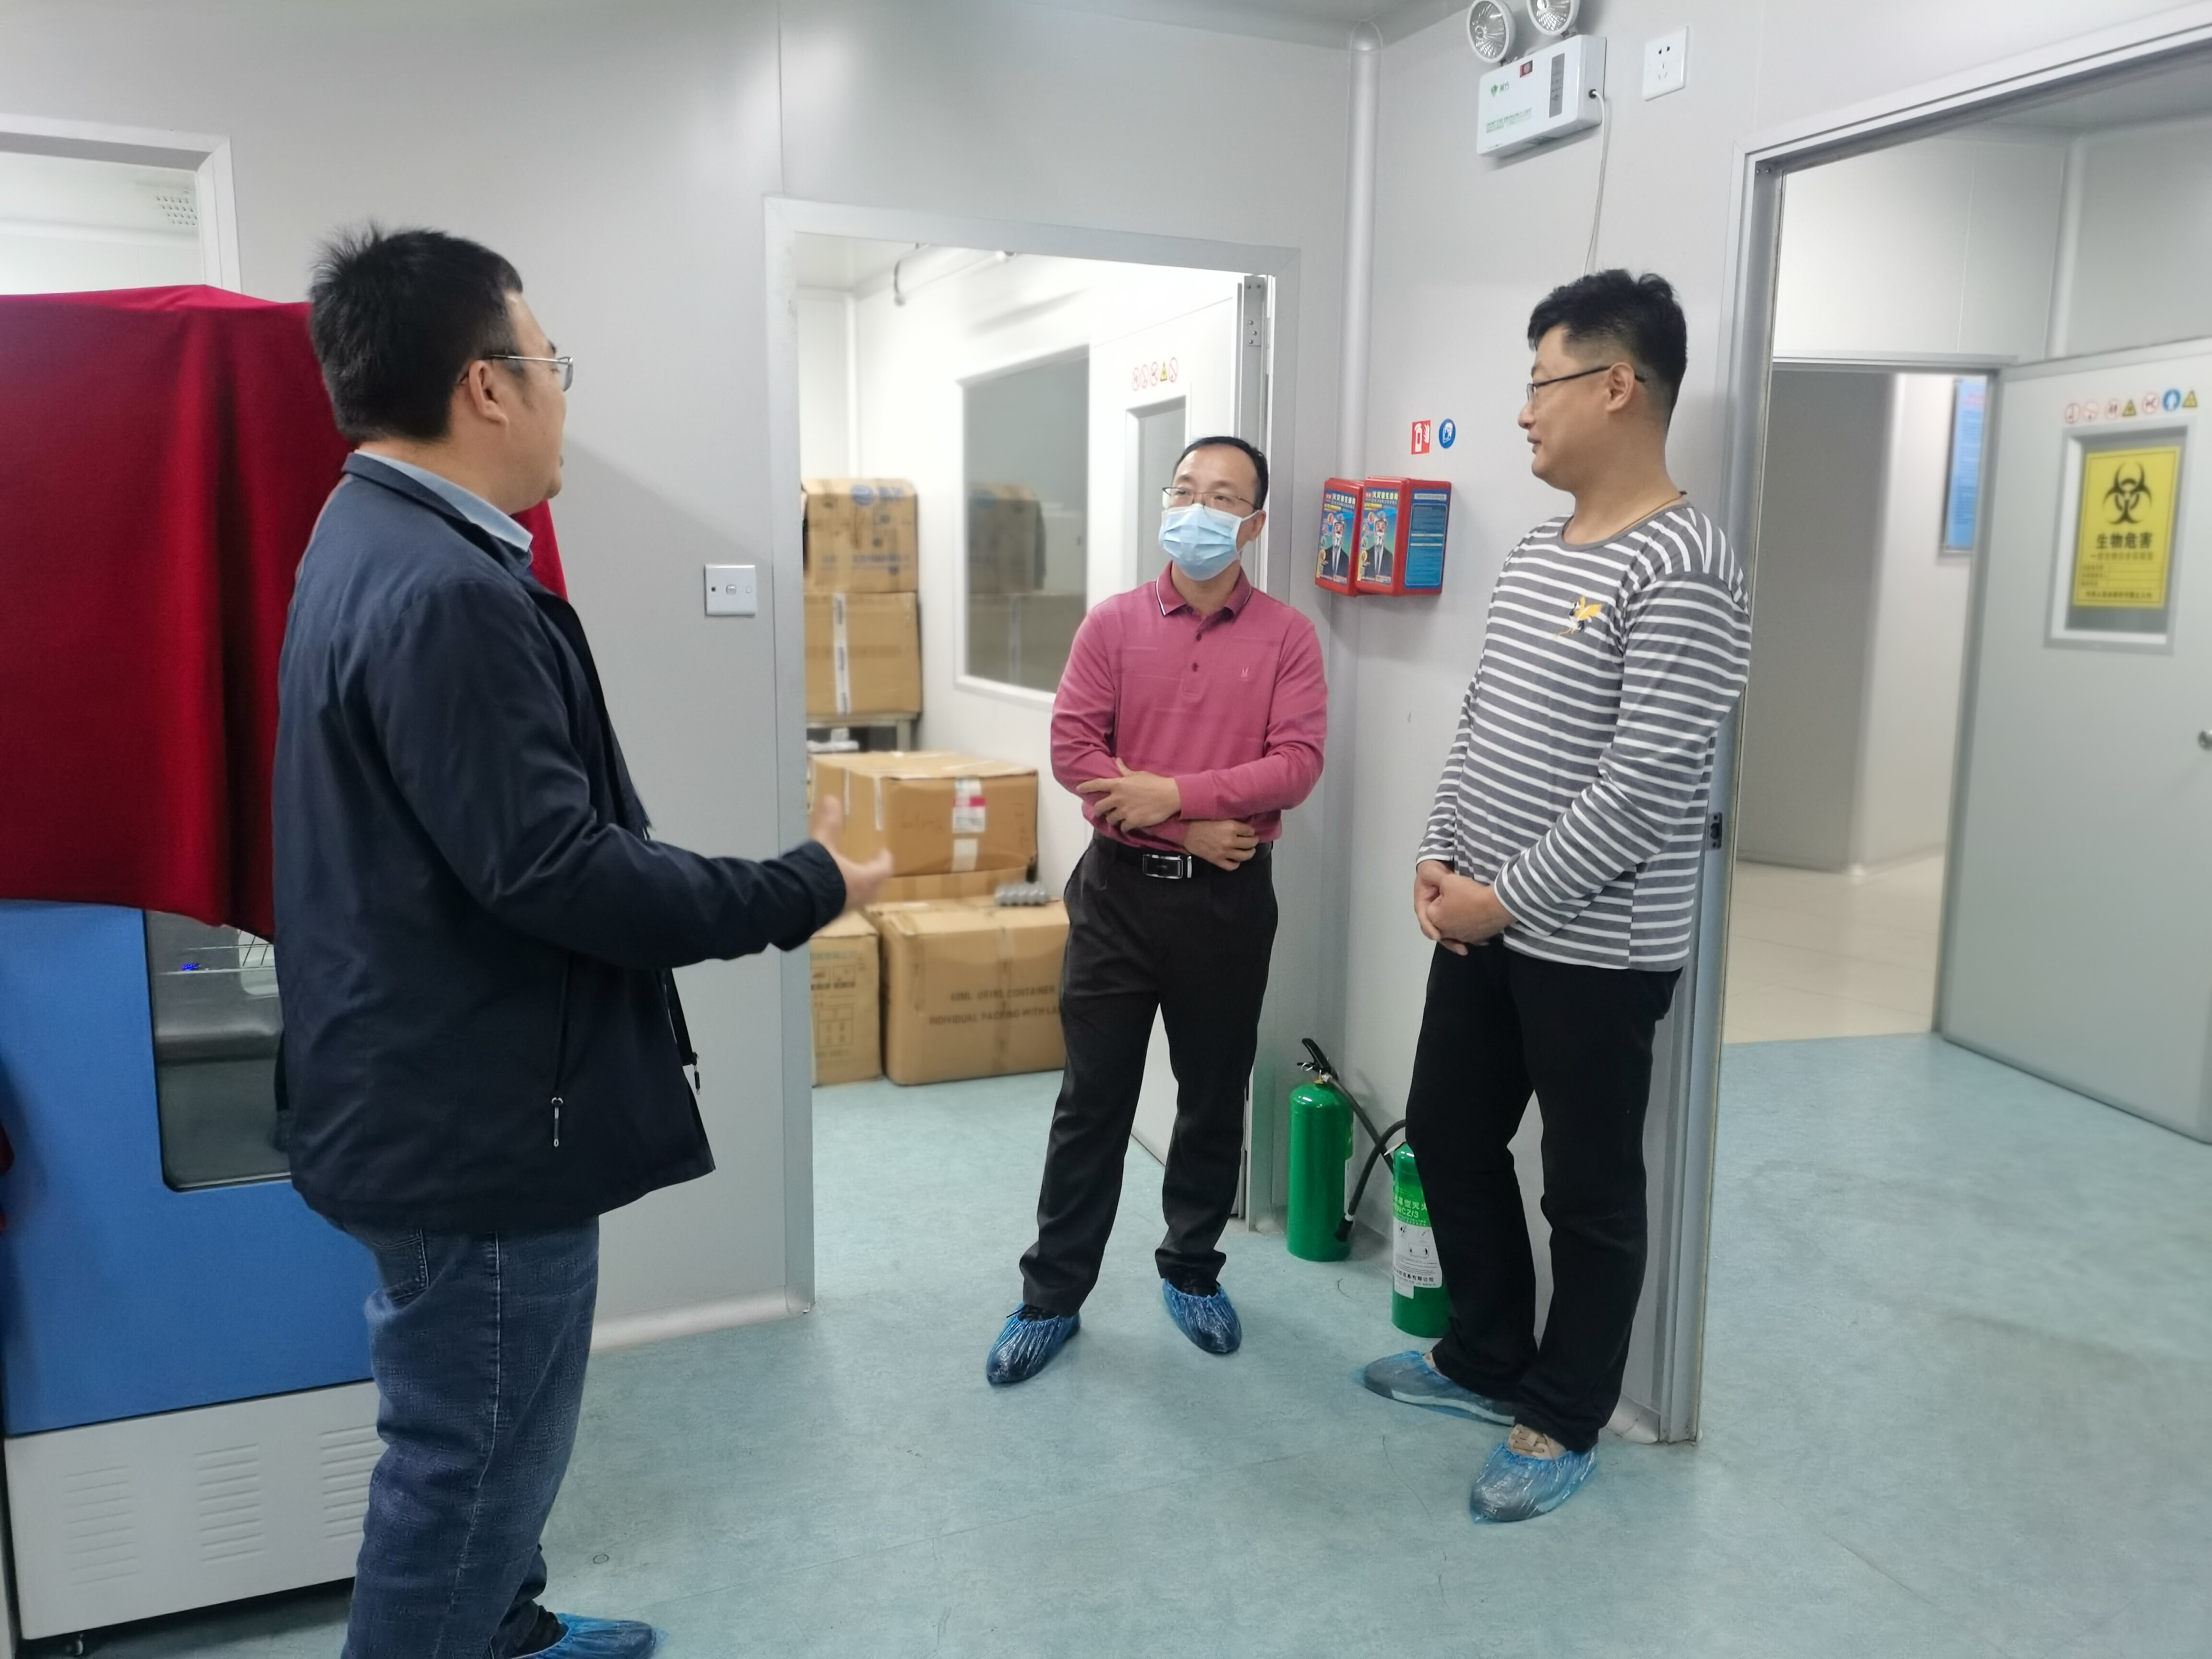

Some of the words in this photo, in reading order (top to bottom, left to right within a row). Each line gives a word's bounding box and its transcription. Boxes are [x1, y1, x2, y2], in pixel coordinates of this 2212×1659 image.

[2096, 531, 2153, 549] 生物危害
[977, 989, 1003, 999] URINE
[1007, 985, 1055, 998] CONTAINER
[930, 1014, 978, 1025] INDIVIDUAL
[982, 1010, 1020, 1021] PACKING
[1022, 1007, 1044, 1017] WITH
